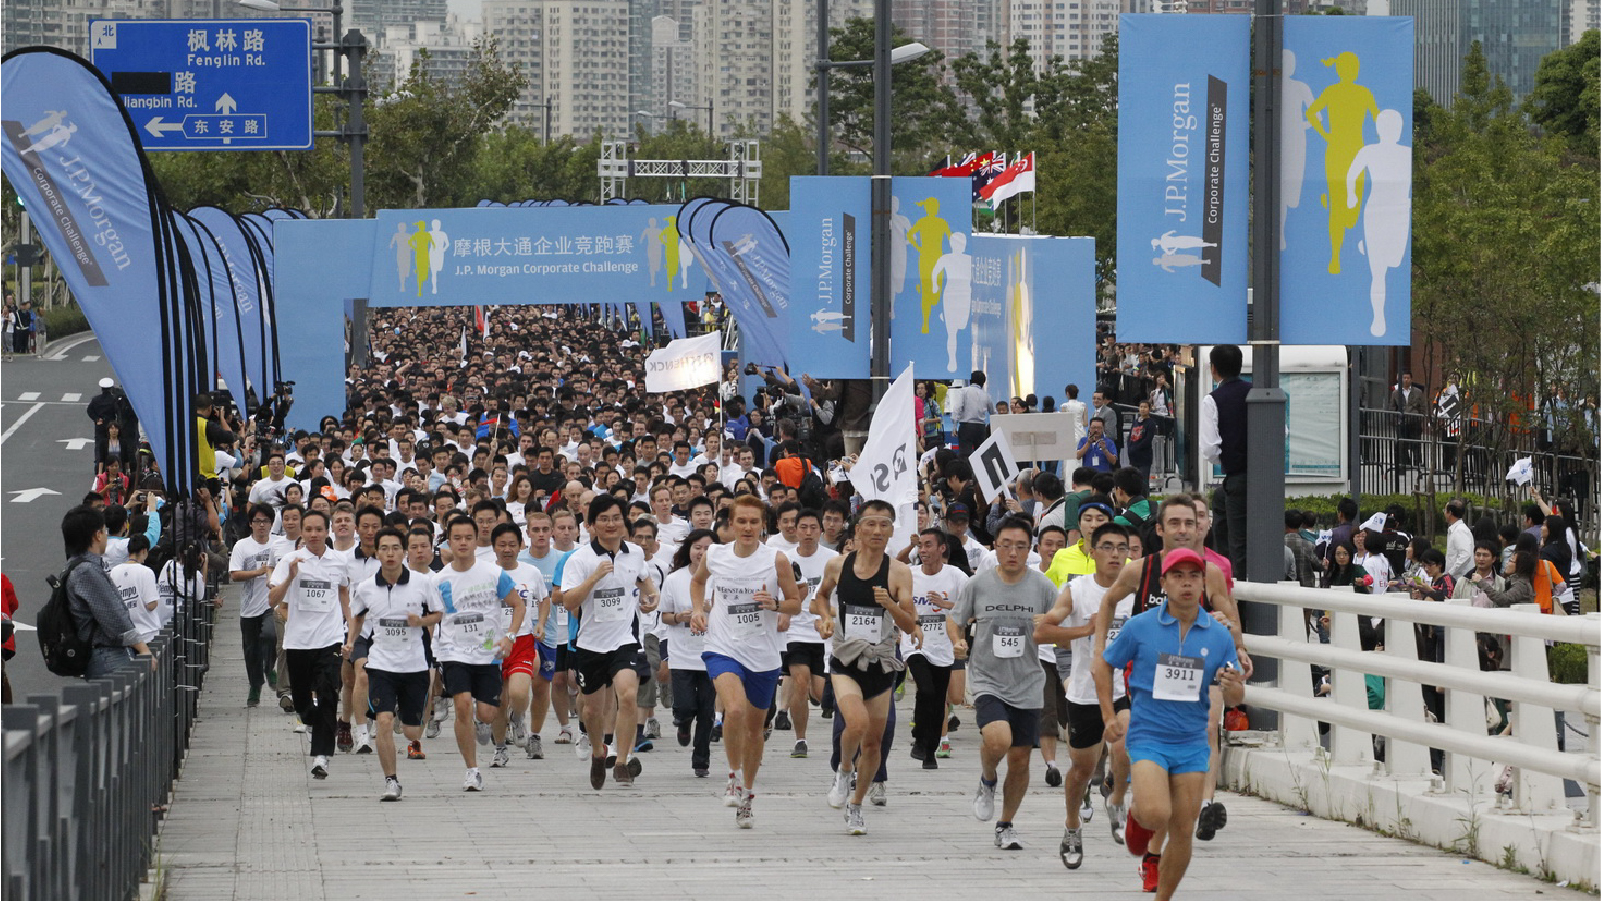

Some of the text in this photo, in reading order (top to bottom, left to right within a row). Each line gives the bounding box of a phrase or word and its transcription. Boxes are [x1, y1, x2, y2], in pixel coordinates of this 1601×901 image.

[102, 24, 114, 37] 北
[187, 28, 265, 52] 枫林路
[187, 53, 266, 69] Fenglin Rd.
[177, 96, 198, 108] Rd.
[194, 119, 258, 134] 东安路
[1165, 82, 1198, 222] J.P.Morgan
[34, 166, 64, 217] Corporate
[1208, 167, 1220, 224] Corporate
[60, 155, 132, 271] J.P.Morgan
[453, 235, 635, 258] 摩根大通企业竞跑赛
[819, 217, 837, 304] J.P.Morgan
[455, 260, 639, 277] J.P. Morgan Corporate Challenge
[306, 589, 326, 598] 1067
[985, 604, 1034, 613] DELPHI
[737, 612, 760, 624] 1005
[851, 616, 876, 626] 2164
[385, 627, 407, 637] 3095
[923, 622, 943, 632] 2772
[1001, 637, 1019, 647] 545
[1165, 668, 1194, 681] 3911
